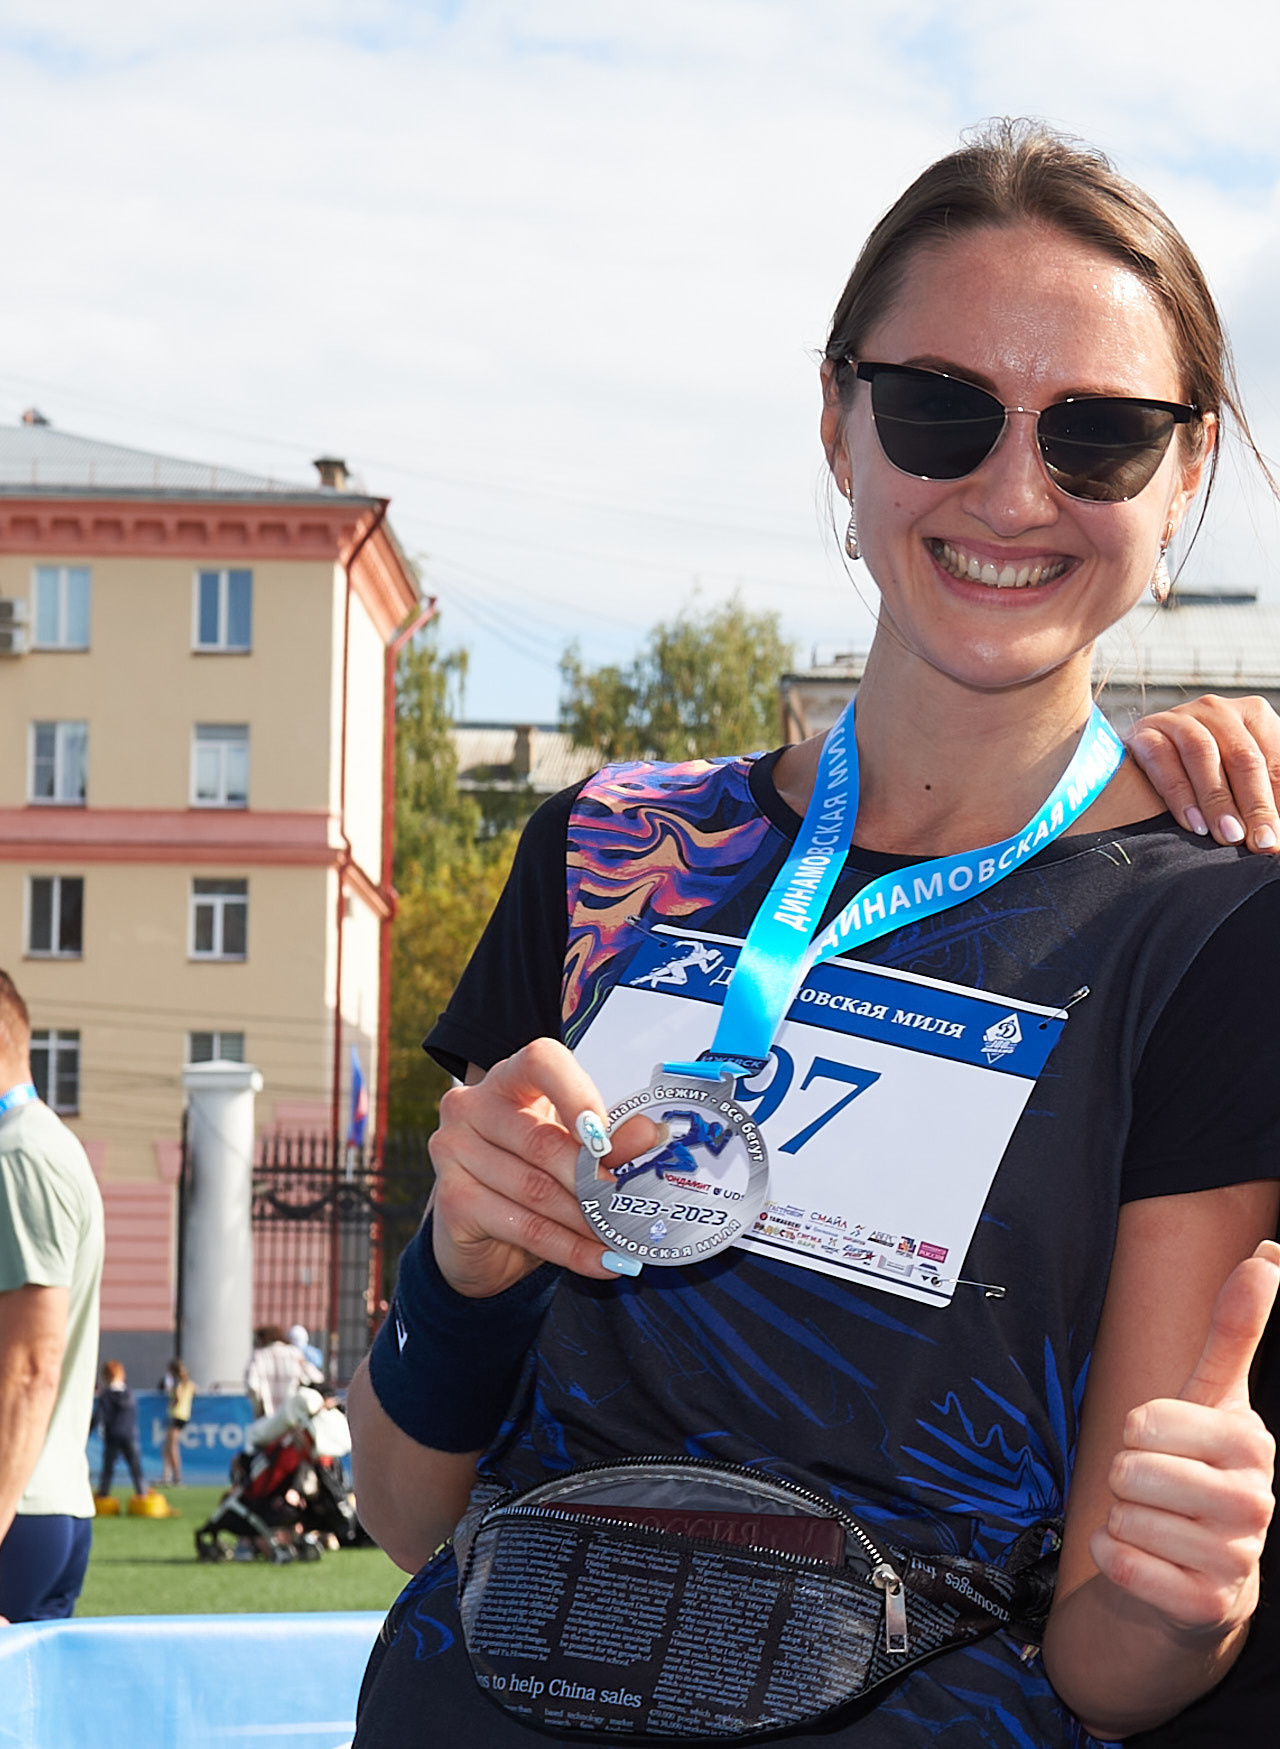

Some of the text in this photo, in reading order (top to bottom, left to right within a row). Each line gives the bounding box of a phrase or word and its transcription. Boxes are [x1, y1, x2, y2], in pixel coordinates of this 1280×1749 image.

[773, 796, 848, 933] ДИНАМОВСКАЯ
[816, 727, 1120, 956] ДИНАМОВСКАЯ МИЛЯ
[891, 1011, 966, 1040] миля
[606, 1092, 650, 1132] инамо
[654, 1085, 709, 1103] бежит
[720, 1100, 745, 1125] все
[741, 1122, 765, 1163] бегут
[735, 1044, 883, 1156] 97
[581, 1199, 741, 1260] Динамовская миля
[609, 1196, 728, 1226] 1923-2023
[809, 1211, 848, 1230] СМАЙЛ
[493, 1675, 507, 1691] to
[509, 1673, 546, 1701] help
[549, 1679, 598, 1703] China
[602, 1688, 644, 1709] sales
